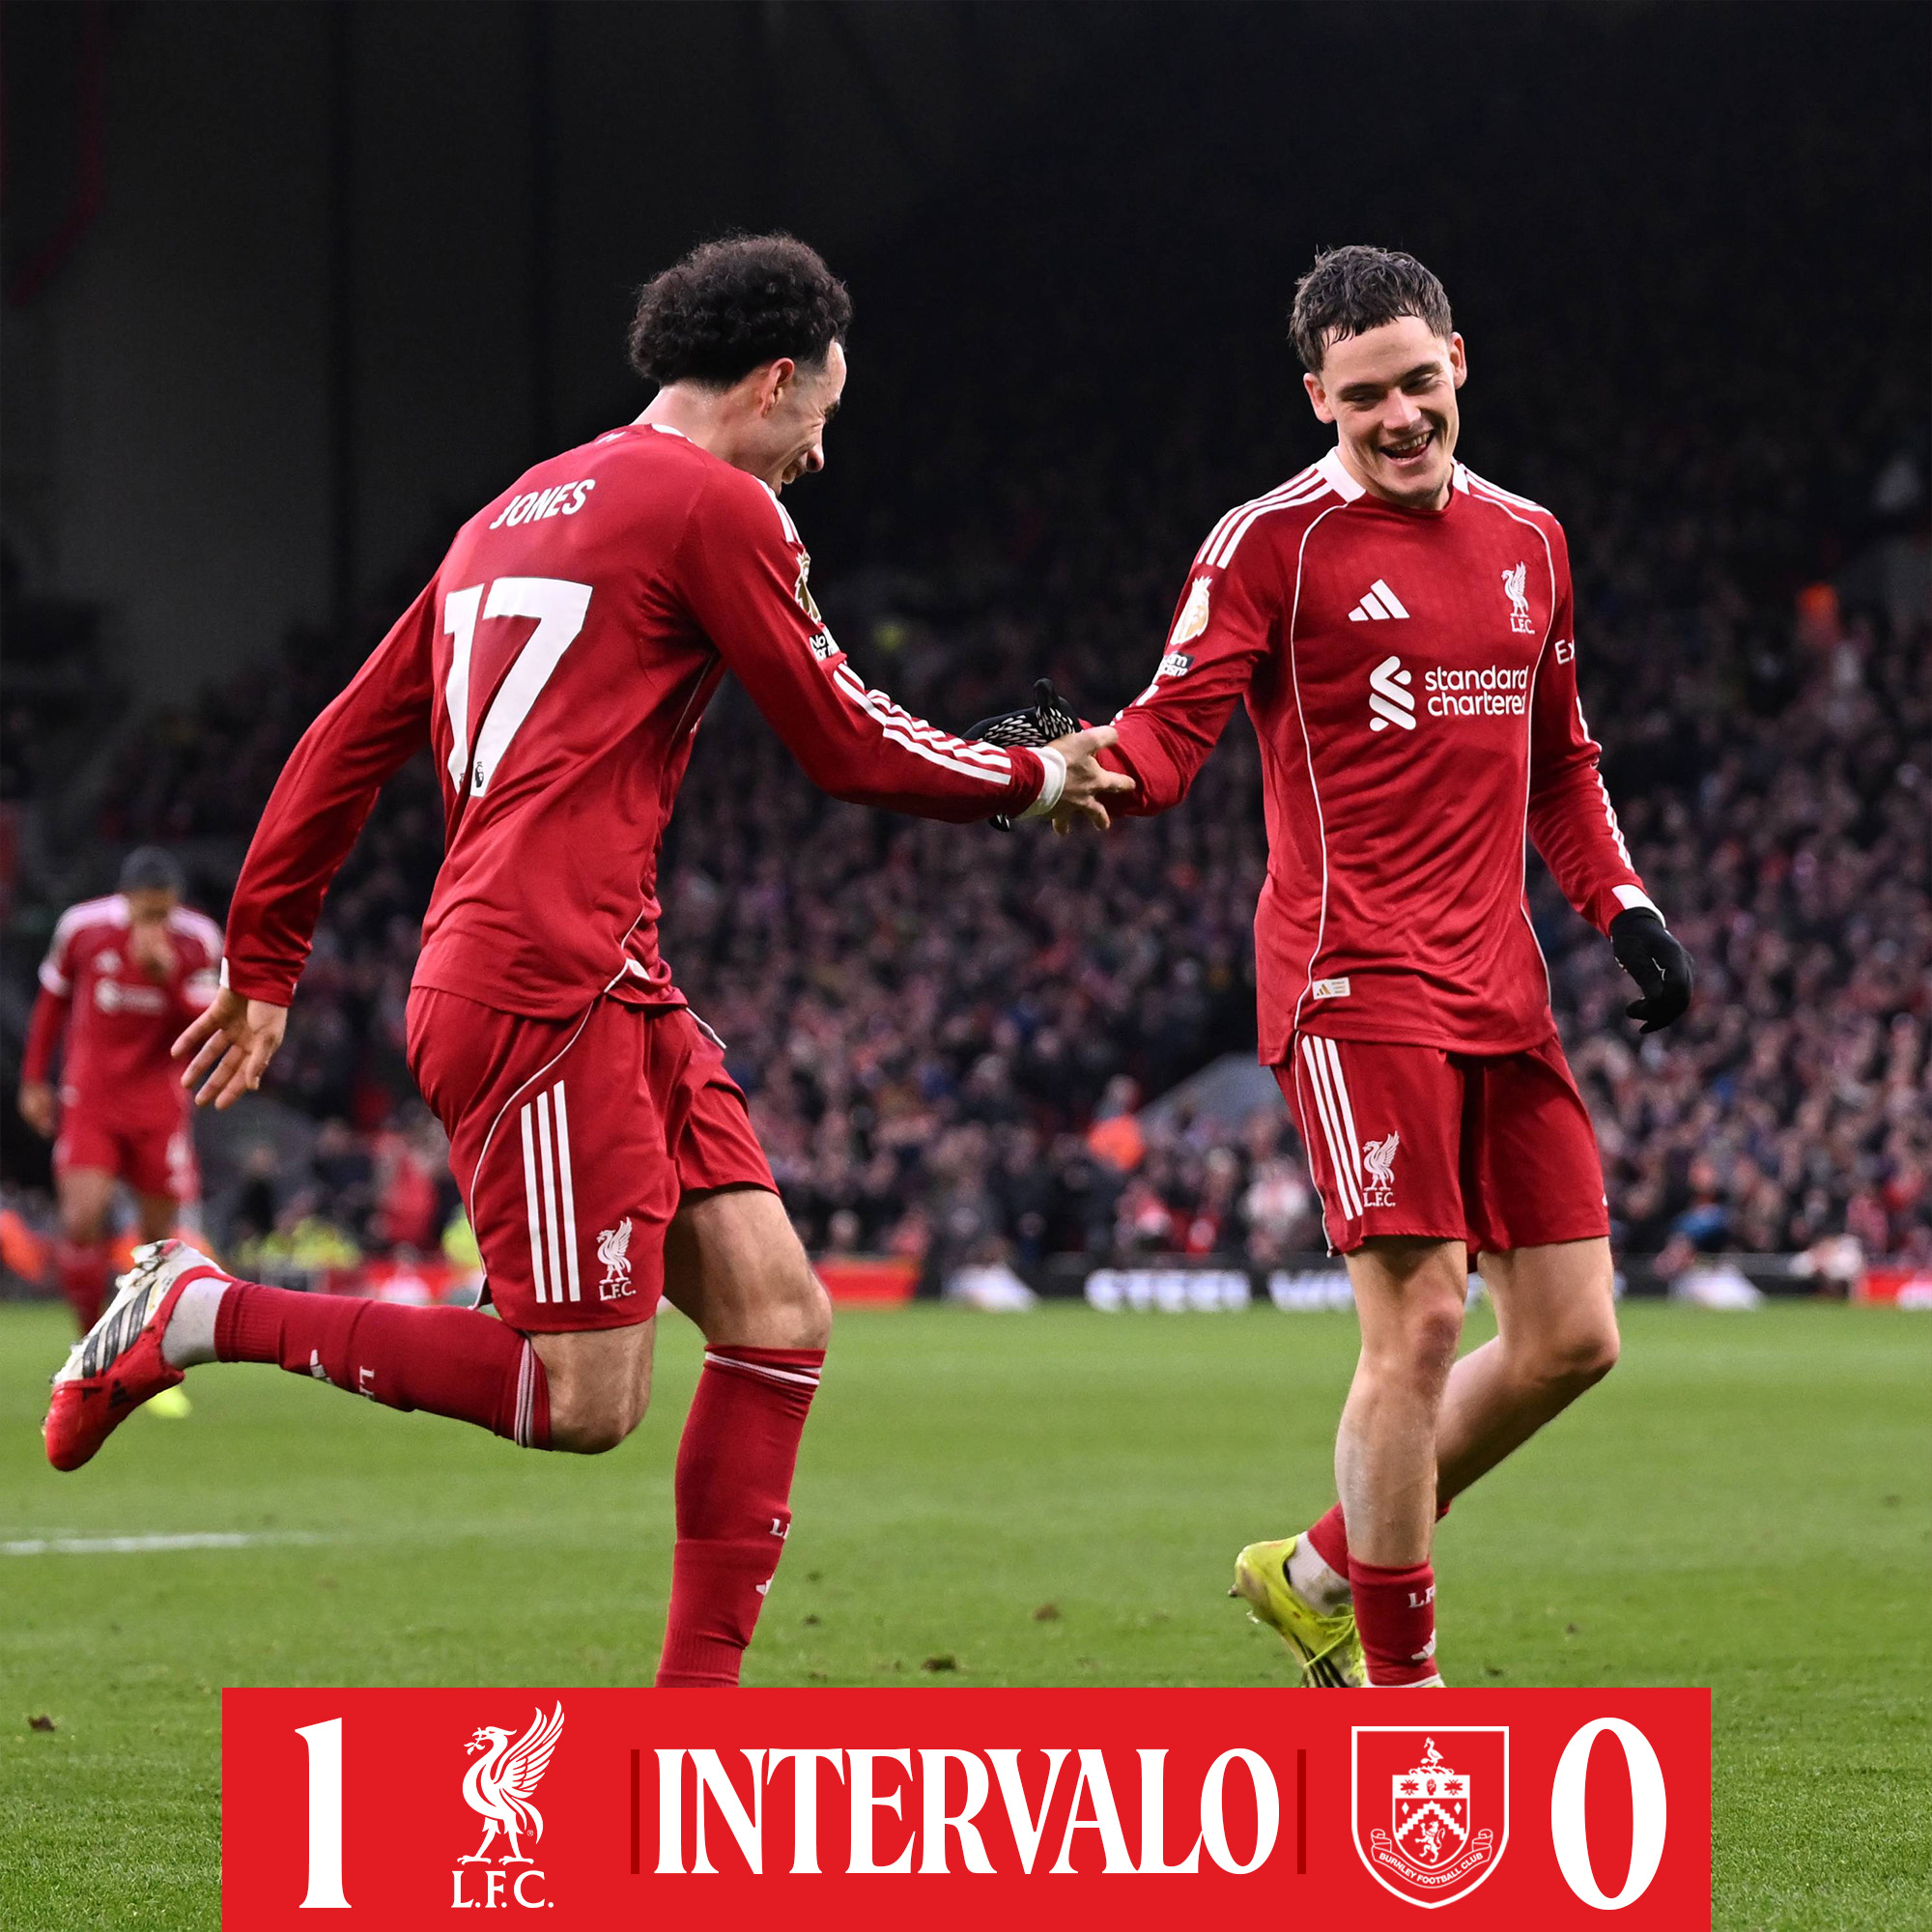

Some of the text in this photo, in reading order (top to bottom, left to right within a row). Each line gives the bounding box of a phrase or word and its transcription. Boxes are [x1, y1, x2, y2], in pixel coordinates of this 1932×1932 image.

[489, 479, 596, 530] JONES
[809, 634, 826, 648] No
[443, 576, 593, 798] 17
[1425, 665, 1529, 691] standard
[1363, 1191, 1396, 1208] L.F.C.
[599, 1281, 637, 1301] L.F.C.
